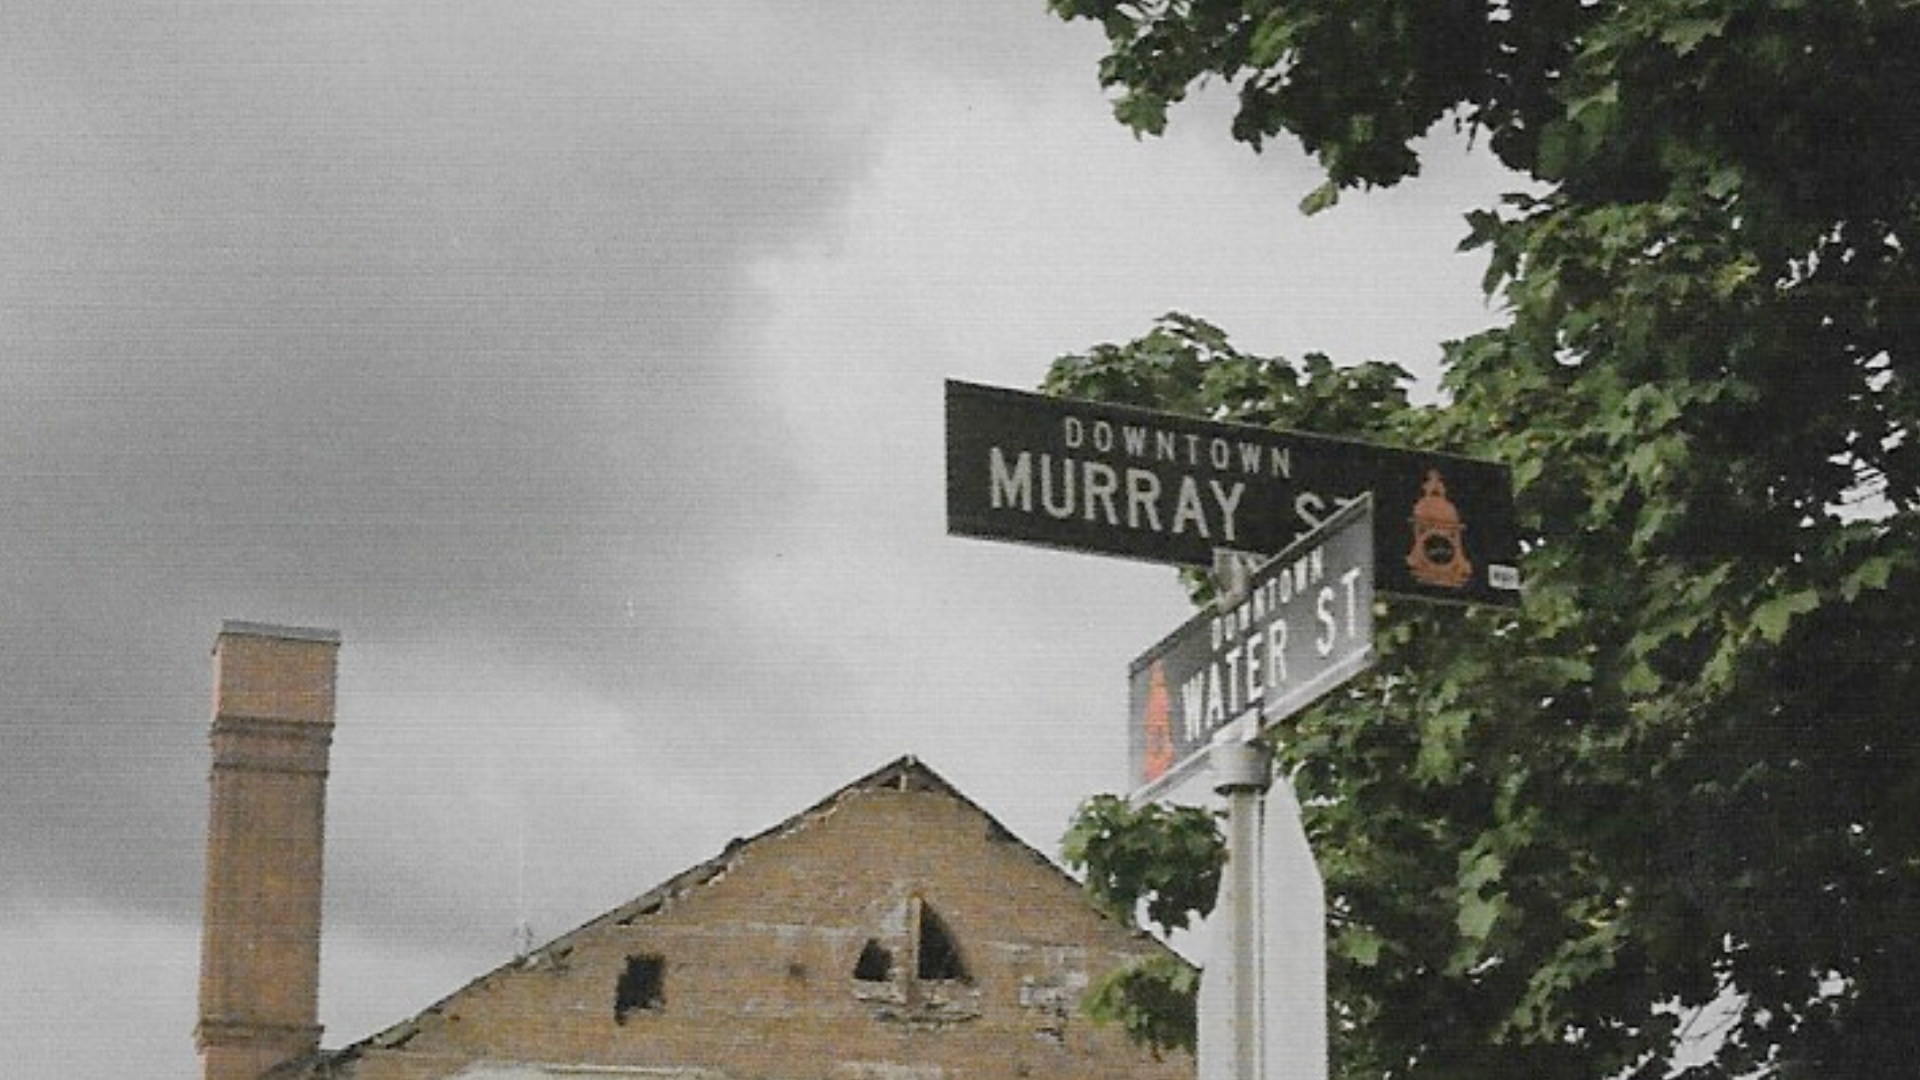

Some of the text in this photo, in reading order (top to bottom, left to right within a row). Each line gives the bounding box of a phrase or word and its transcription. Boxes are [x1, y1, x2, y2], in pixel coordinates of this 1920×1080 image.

[988, 446, 1355, 542] MURRAY S
[1064, 415, 1292, 480] DOWNTOWN
[1210, 545, 1324, 652] DOWNTOWN
[1181, 566, 1362, 743] WATER ST
